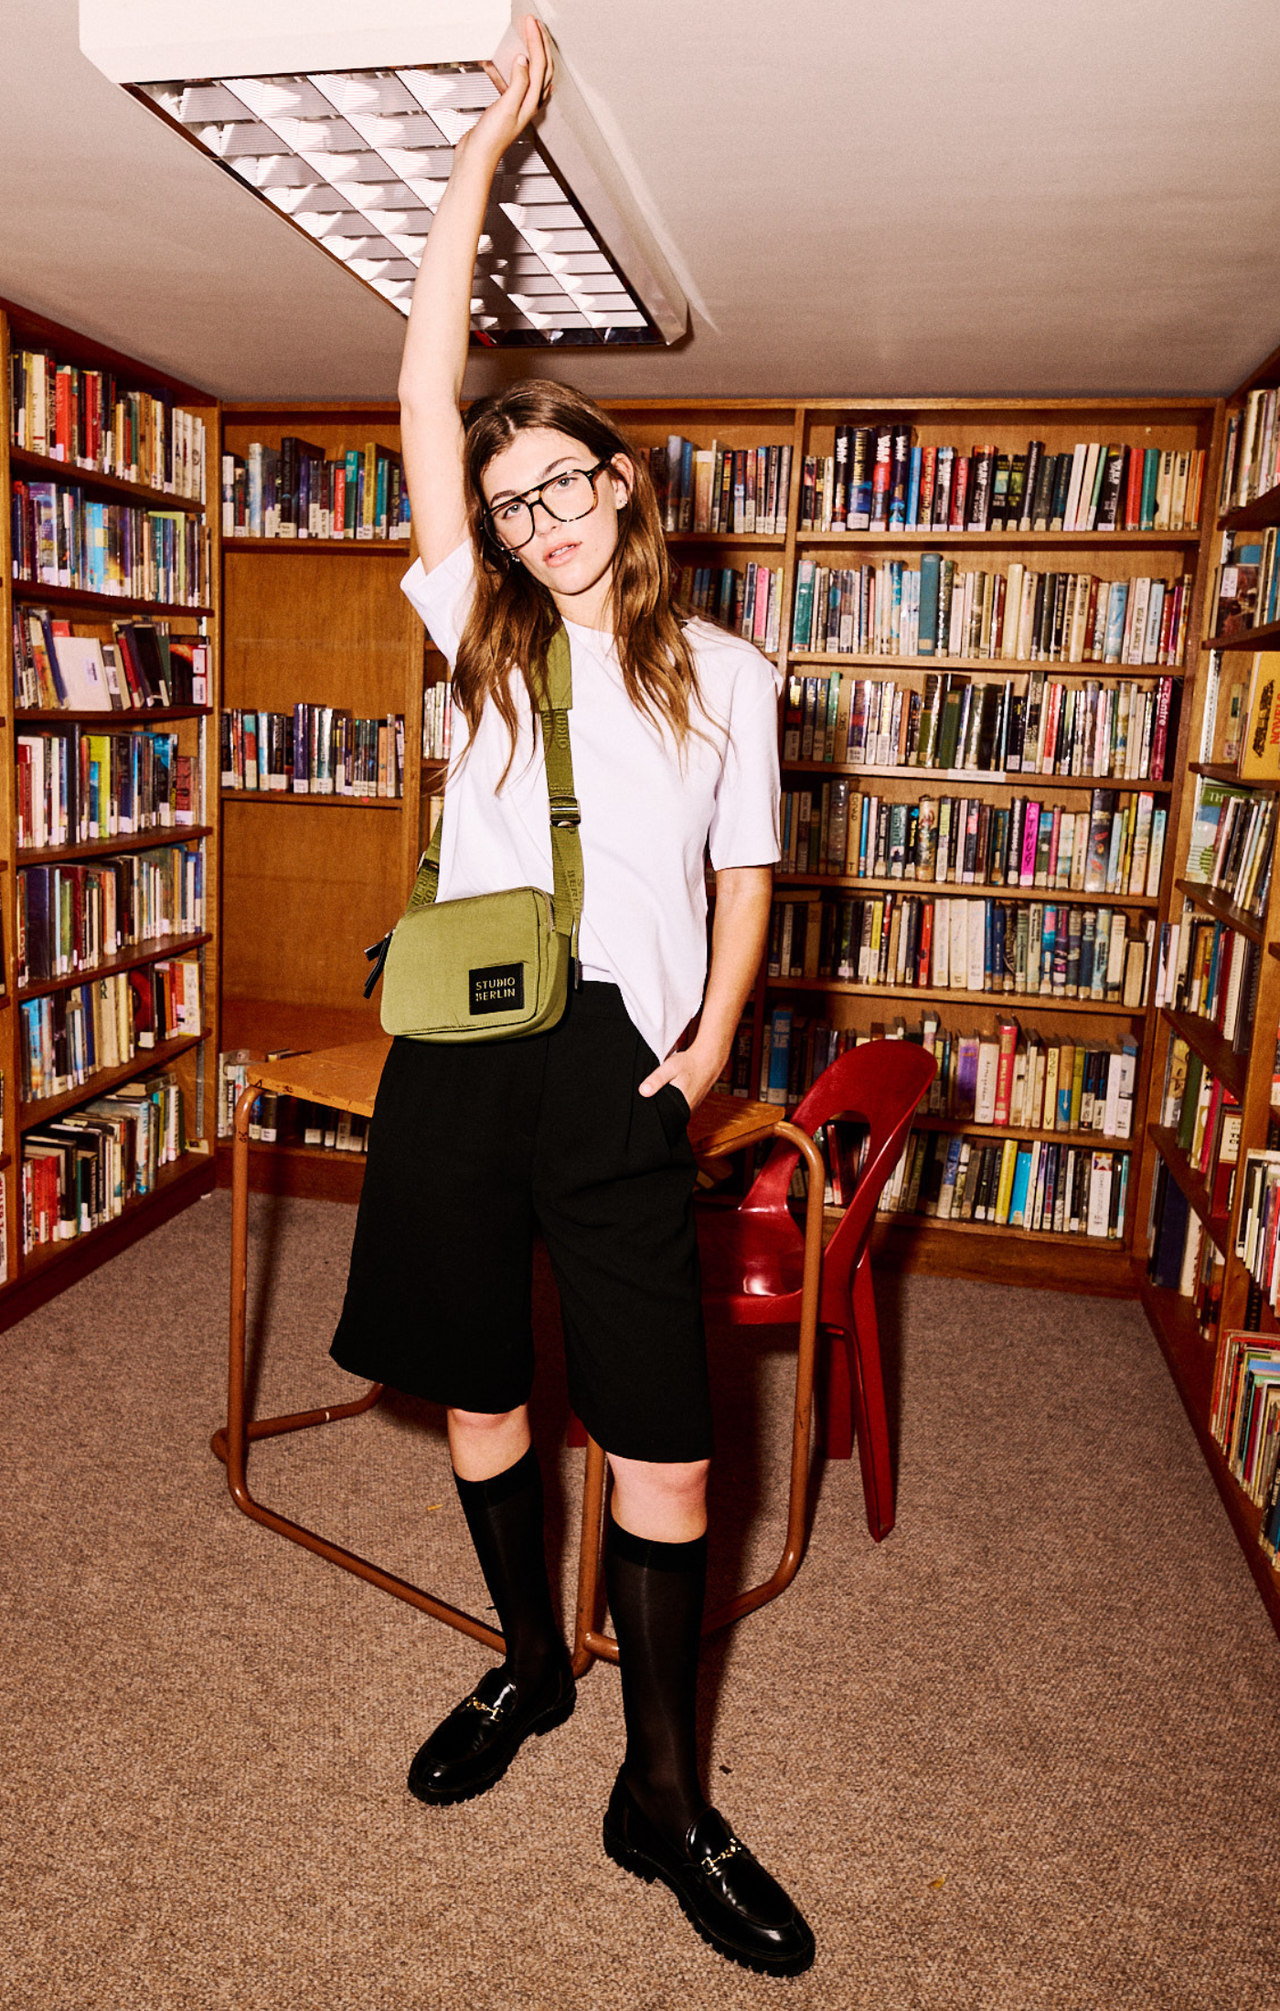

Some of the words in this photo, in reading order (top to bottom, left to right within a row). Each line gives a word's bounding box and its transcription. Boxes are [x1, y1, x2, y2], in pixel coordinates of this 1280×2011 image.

[1159, 692, 1169, 726] centre
[475, 977, 516, 991] STUDIO
[475, 988, 516, 1002] BERLIN
